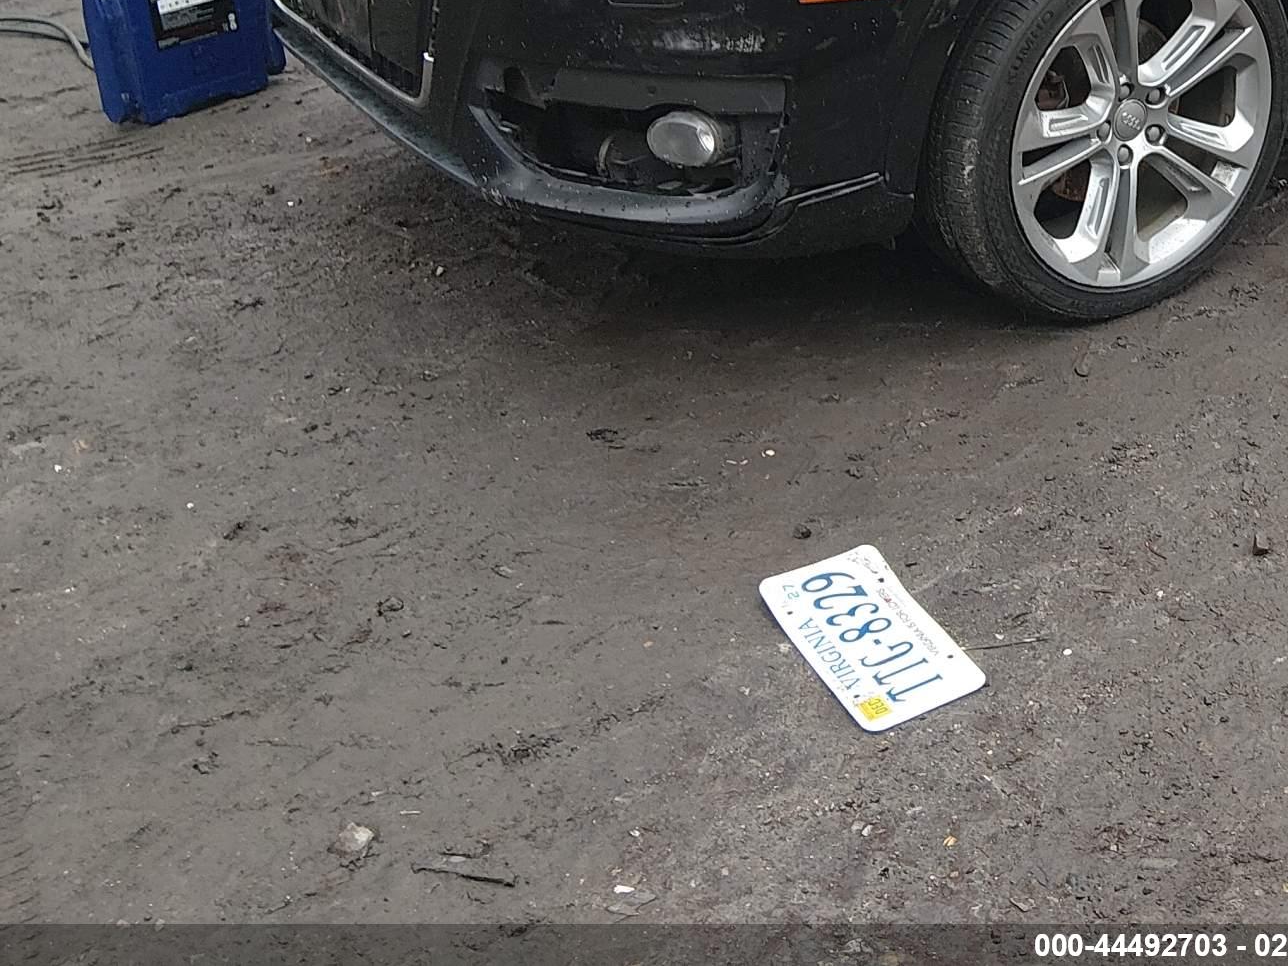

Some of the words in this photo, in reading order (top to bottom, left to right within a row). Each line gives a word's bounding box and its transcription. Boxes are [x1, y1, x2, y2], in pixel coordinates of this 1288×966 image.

[782, 584, 800, 600] 27
[798, 617, 860, 690] VIRGINIA
[801, 572, 943, 702] TTG-8329
[868, 698, 888, 715] DEC
